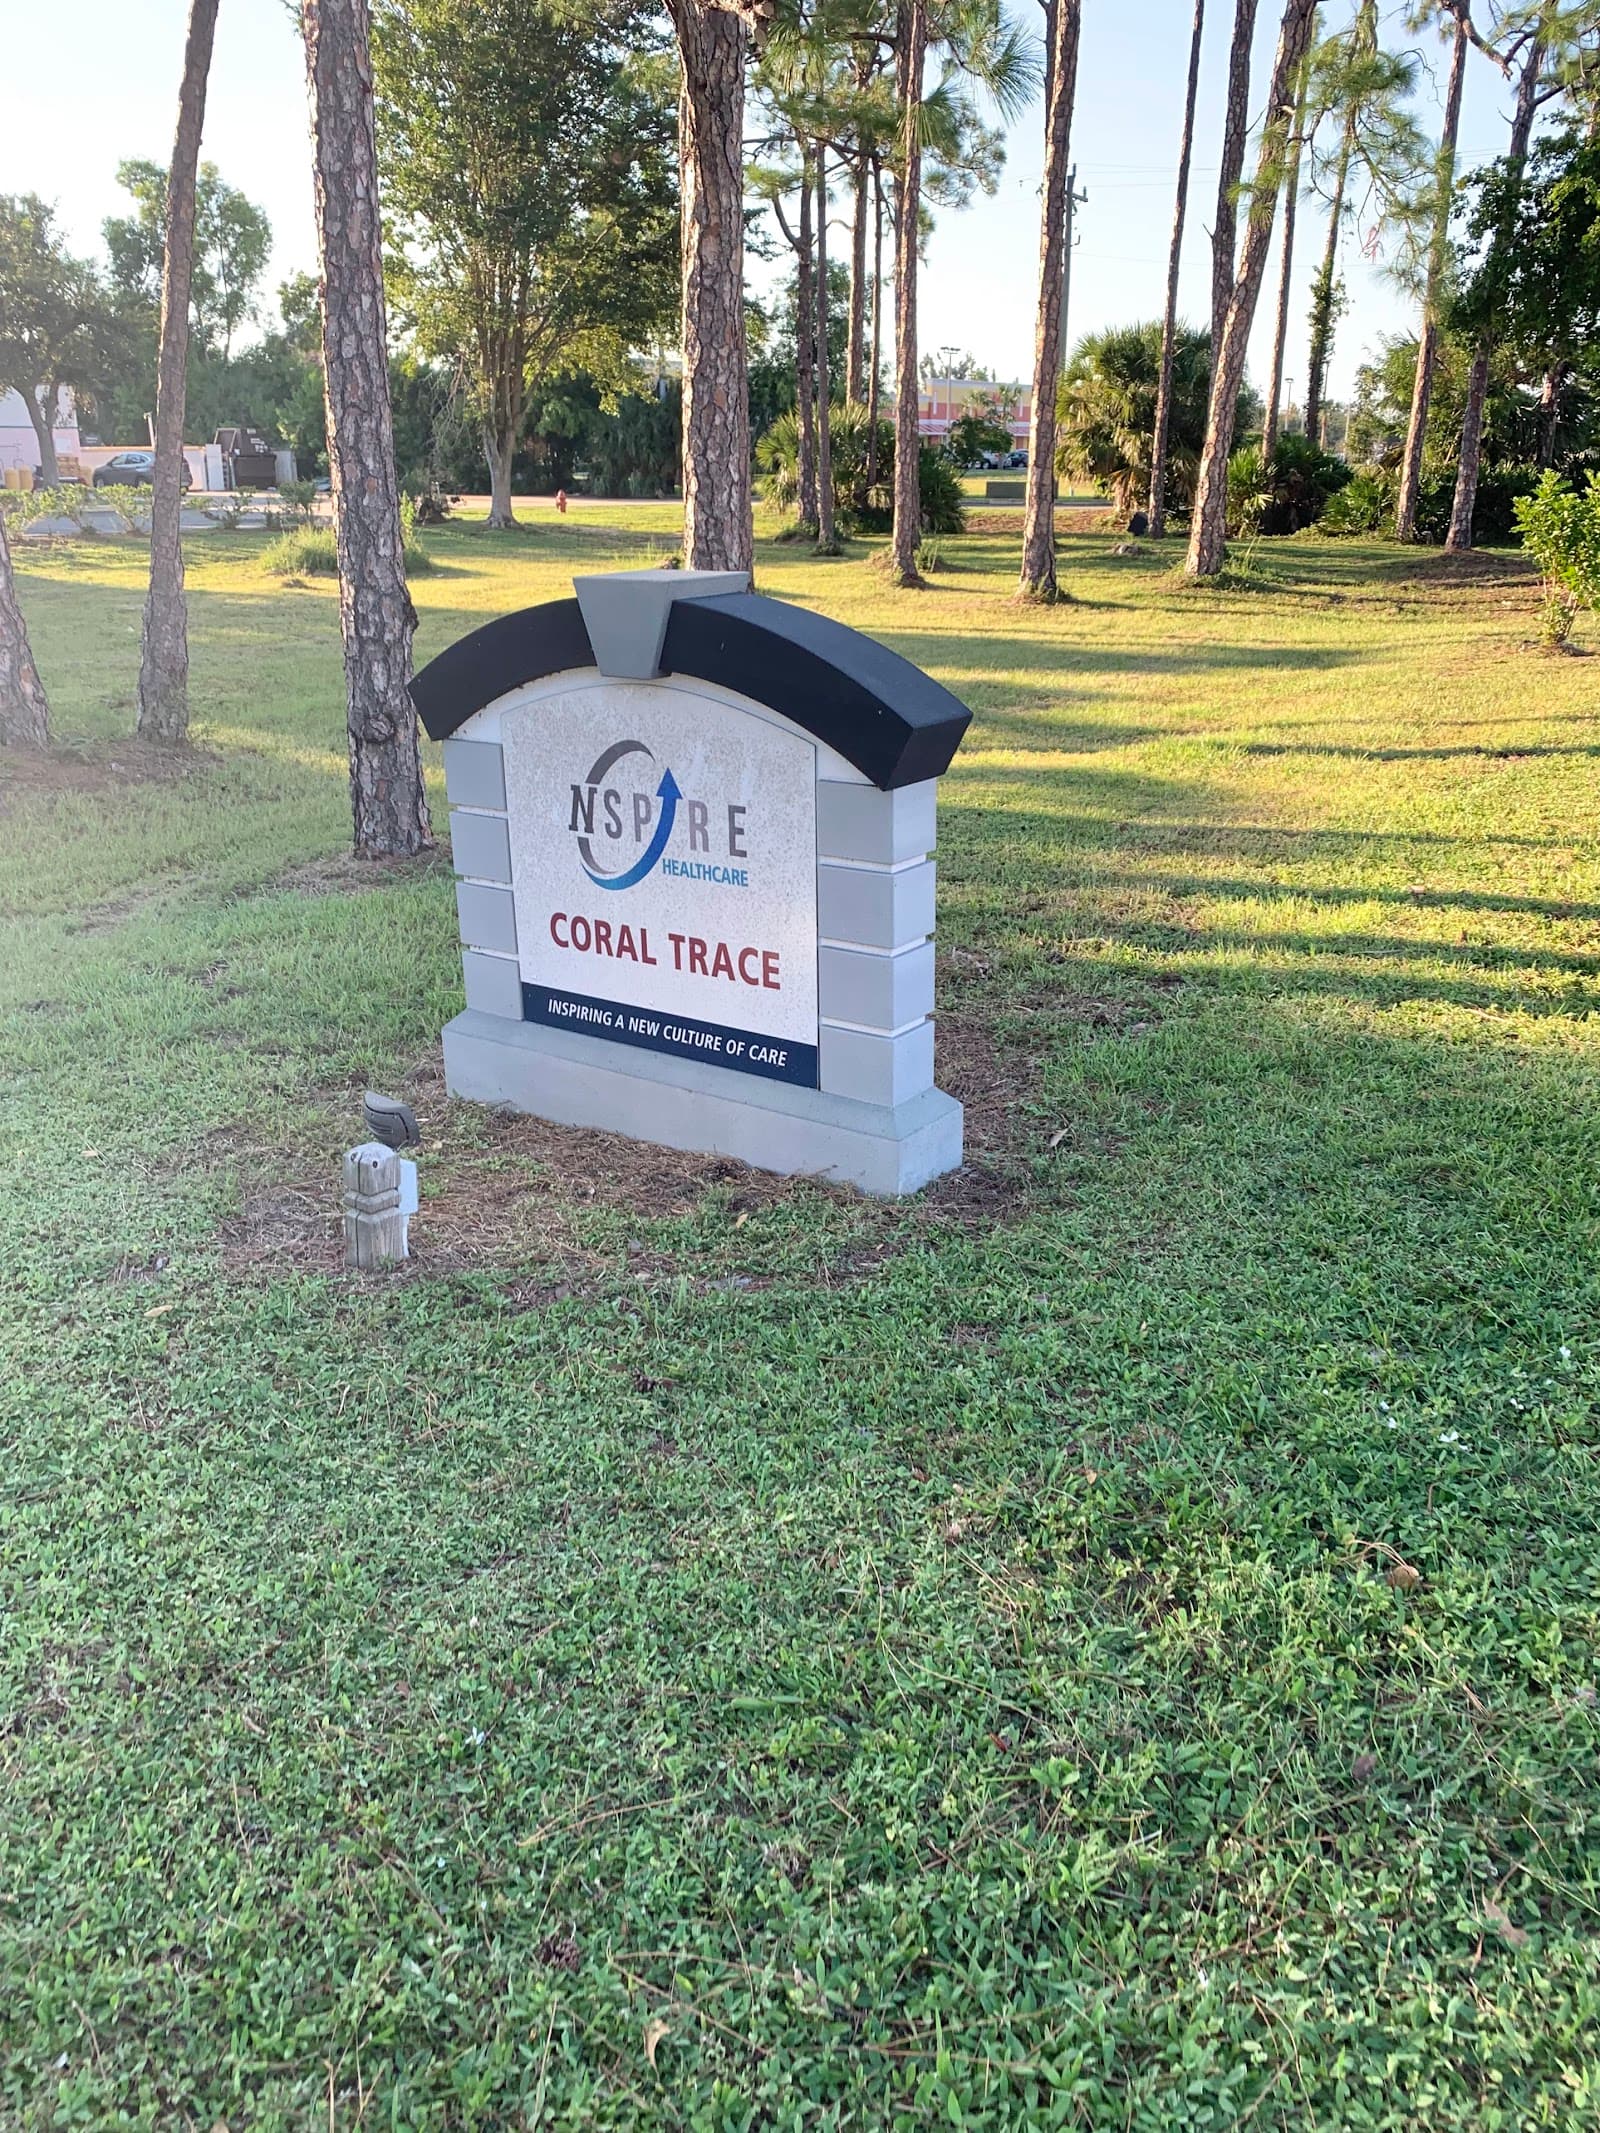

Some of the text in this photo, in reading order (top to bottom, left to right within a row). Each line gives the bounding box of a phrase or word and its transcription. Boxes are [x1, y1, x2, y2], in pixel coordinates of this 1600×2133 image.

[662, 858, 749, 887] HEALTHCARE
[550, 912, 781, 990] CORAL TRACE
[548, 998, 788, 1067] INSPIRING A NEW CULTURE OF CARE
